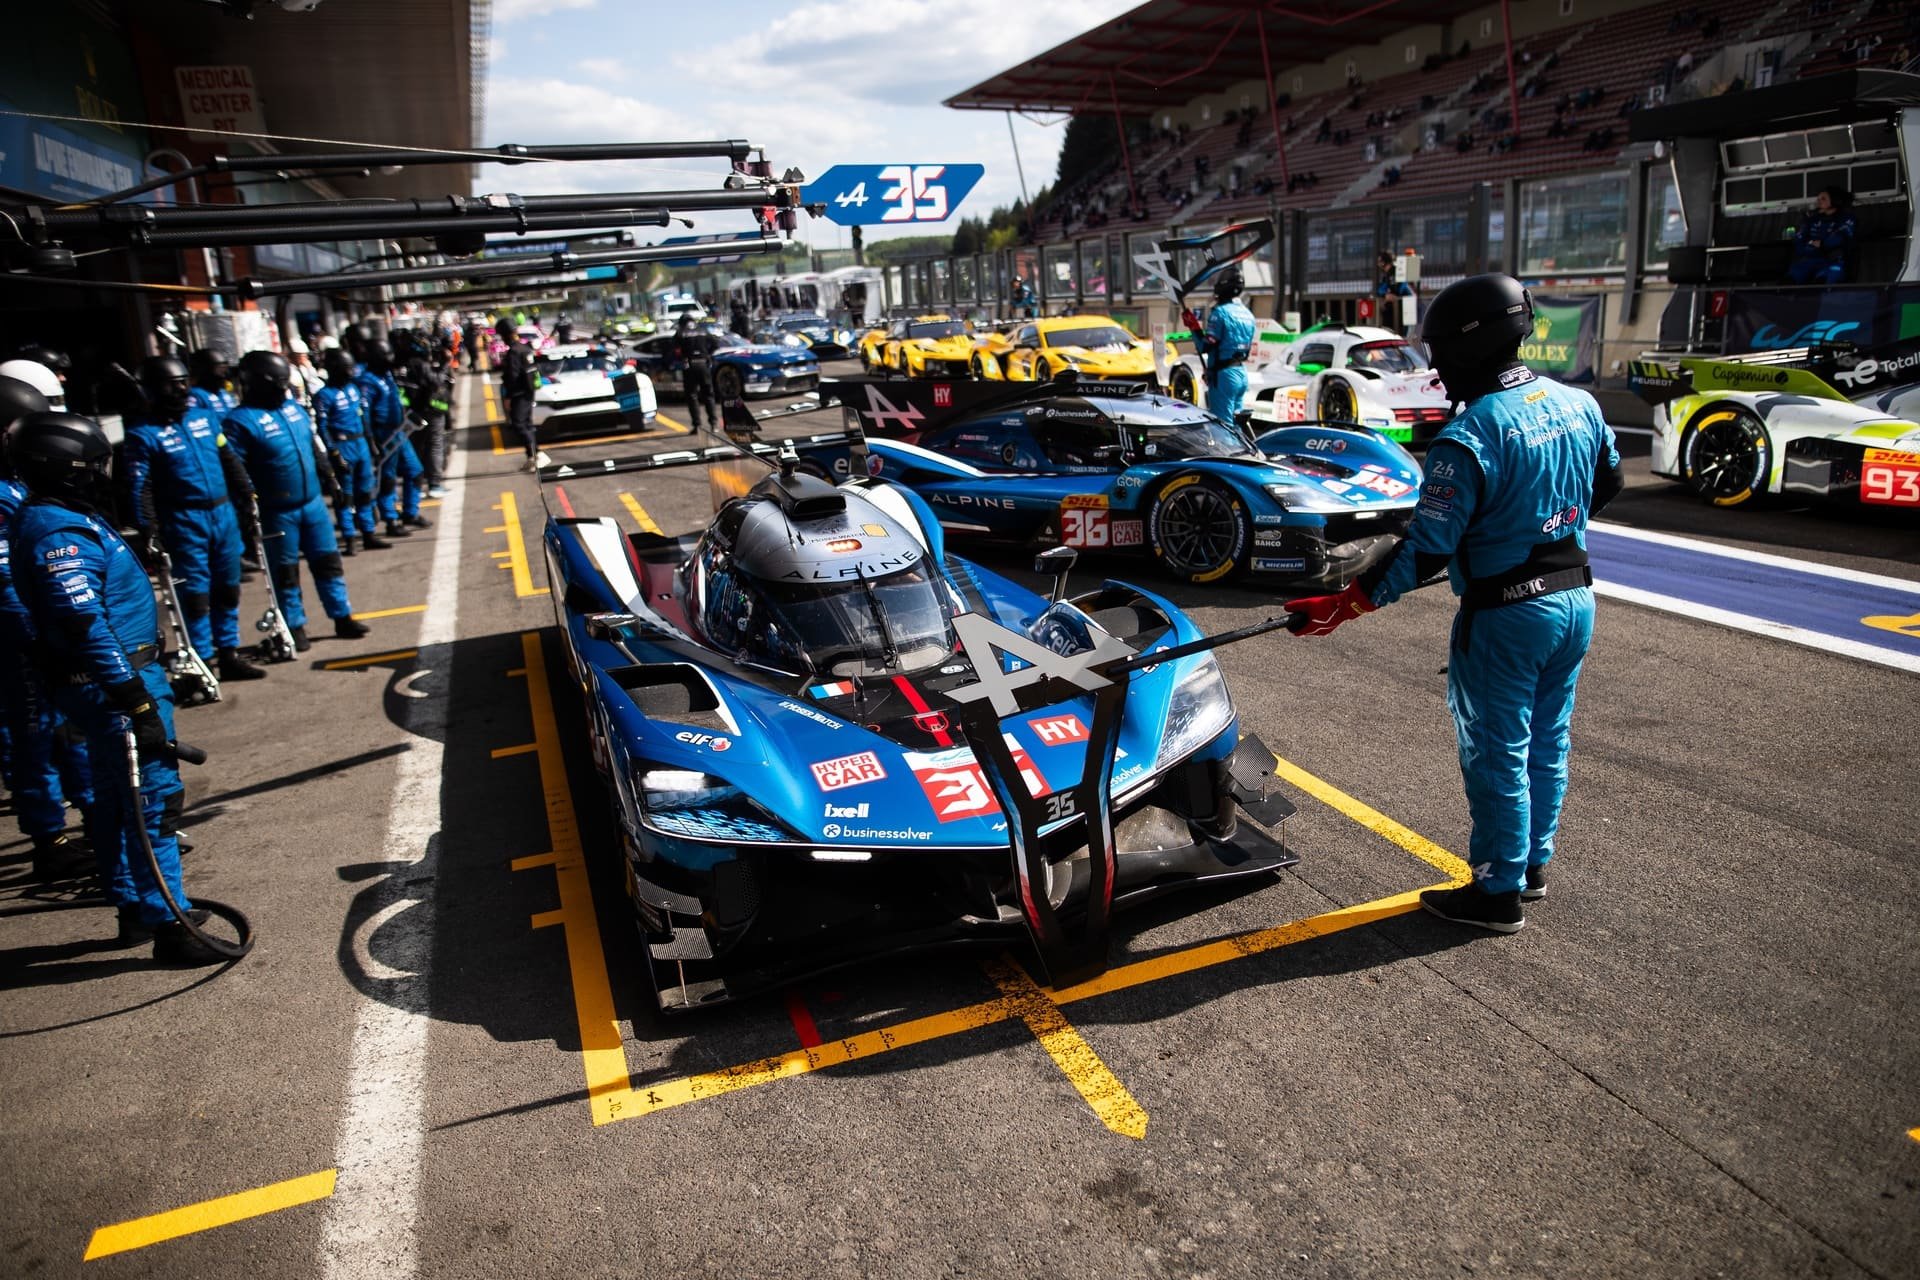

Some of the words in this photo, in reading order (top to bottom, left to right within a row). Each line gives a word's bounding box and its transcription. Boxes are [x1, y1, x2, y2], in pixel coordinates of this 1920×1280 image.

[180, 70, 253, 89] MEDICAL
[191, 94, 252, 113] CENTER
[212, 118, 238, 136] PIT
[878, 165, 948, 222] 35
[1715, 296, 1724, 313] 7
[1881, 352, 1920, 373] Total
[1632, 376, 1673, 387] PEUGEOT
[1712, 366, 1774, 386] Capgemini
[934, 387, 950, 403] HY
[1076, 385, 1128, 395] ALPINE
[1506, 401, 1585, 441] ALPINE
[1873, 451, 1919, 464] DHL
[1116, 477, 1141, 488] GCR
[1866, 467, 1920, 502] 93
[932, 493, 1016, 510] ALPINE
[1067, 495, 1103, 507] DHL
[1062, 510, 1109, 547] 36
[1113, 522, 1141, 531] HYPER
[1543, 511, 1563, 534] elf
[1113, 531, 1141, 544] CAR
[46, 547, 67, 559] elf
[782, 551, 918, 580] ALPINE
[1503, 578, 1546, 602] MRTC
[1033, 718, 1081, 740] HY
[676, 731, 711, 746] elf
[816, 753, 874, 776] HYPER
[821, 763, 881, 790] CAR
[824, 803, 869, 819] ixell
[1045, 791, 1075, 822] 35
[843, 825, 933, 841] businessolver
